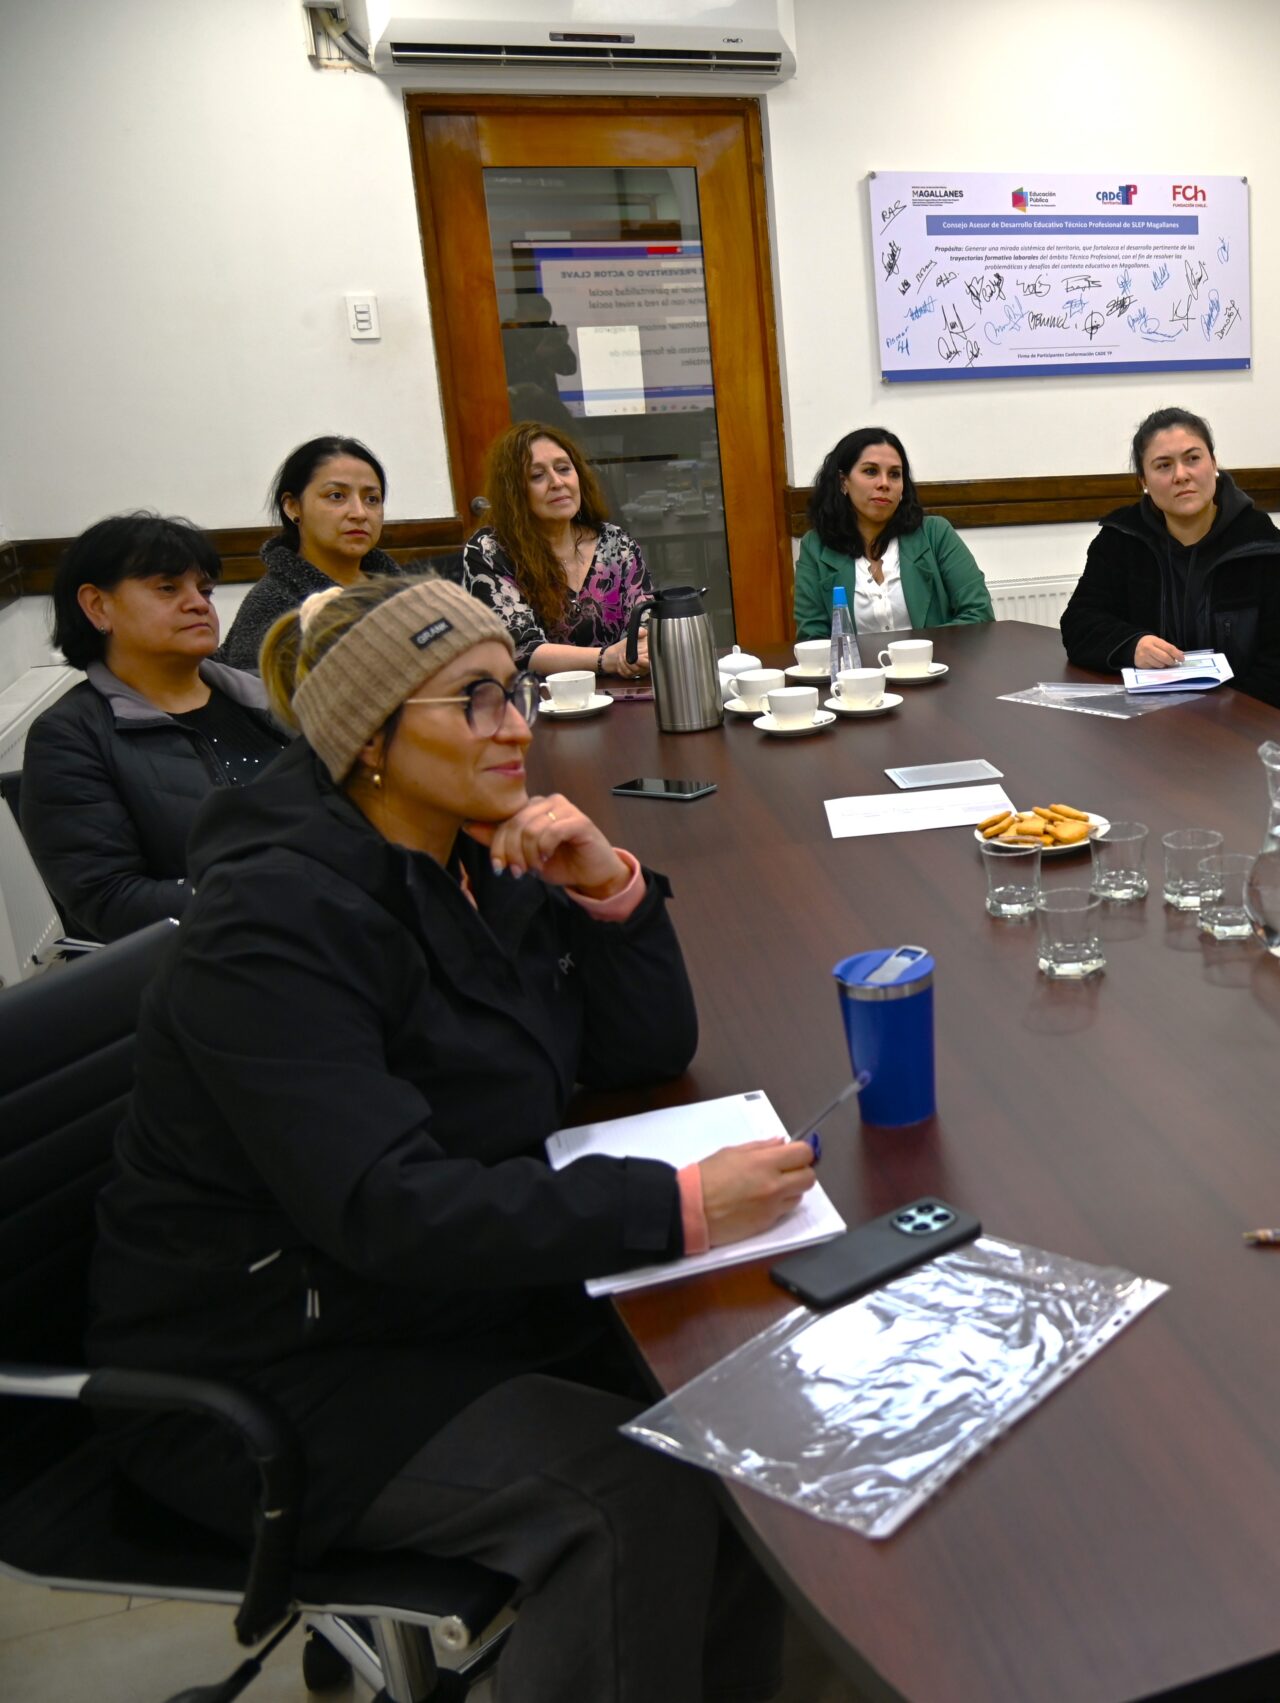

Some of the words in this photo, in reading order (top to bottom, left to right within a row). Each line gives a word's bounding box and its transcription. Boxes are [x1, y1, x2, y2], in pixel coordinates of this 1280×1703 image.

[912, 190, 963, 198] MAGALLANES
[1172, 185, 1206, 201] FCh
[942, 221, 968, 230] Consejo
[991, 221, 999, 229] de
[1000, 221, 1032, 229] Desarrollo
[1033, 221, 1064, 229] Educativo
[1089, 221, 1122, 229] Profesional
[1147, 221, 1179, 230] Magallanes
